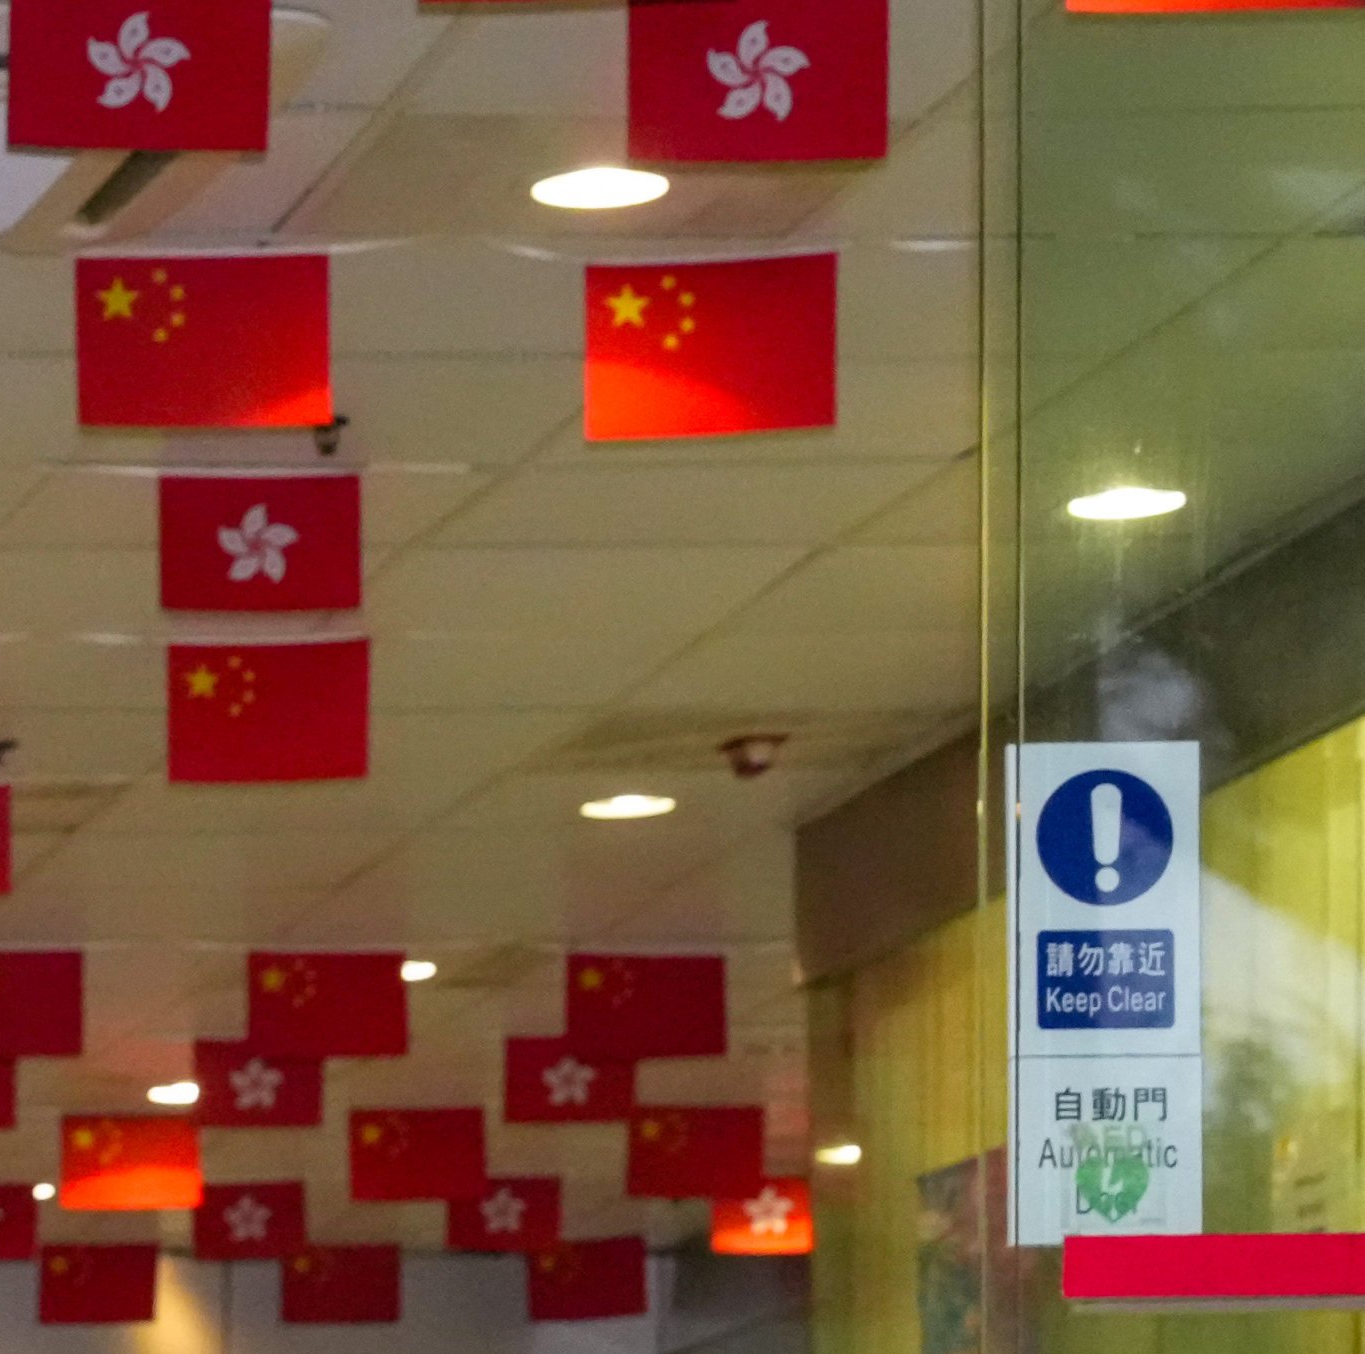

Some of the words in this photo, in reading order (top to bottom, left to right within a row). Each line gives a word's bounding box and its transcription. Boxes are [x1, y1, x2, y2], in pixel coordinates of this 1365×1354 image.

[1045, 941, 1167, 977] 請勿靠近
[1045, 986, 1103, 1018] Keep
[1107, 985, 1167, 1012] Clear
[1054, 1087, 1169, 1122] 自動門
